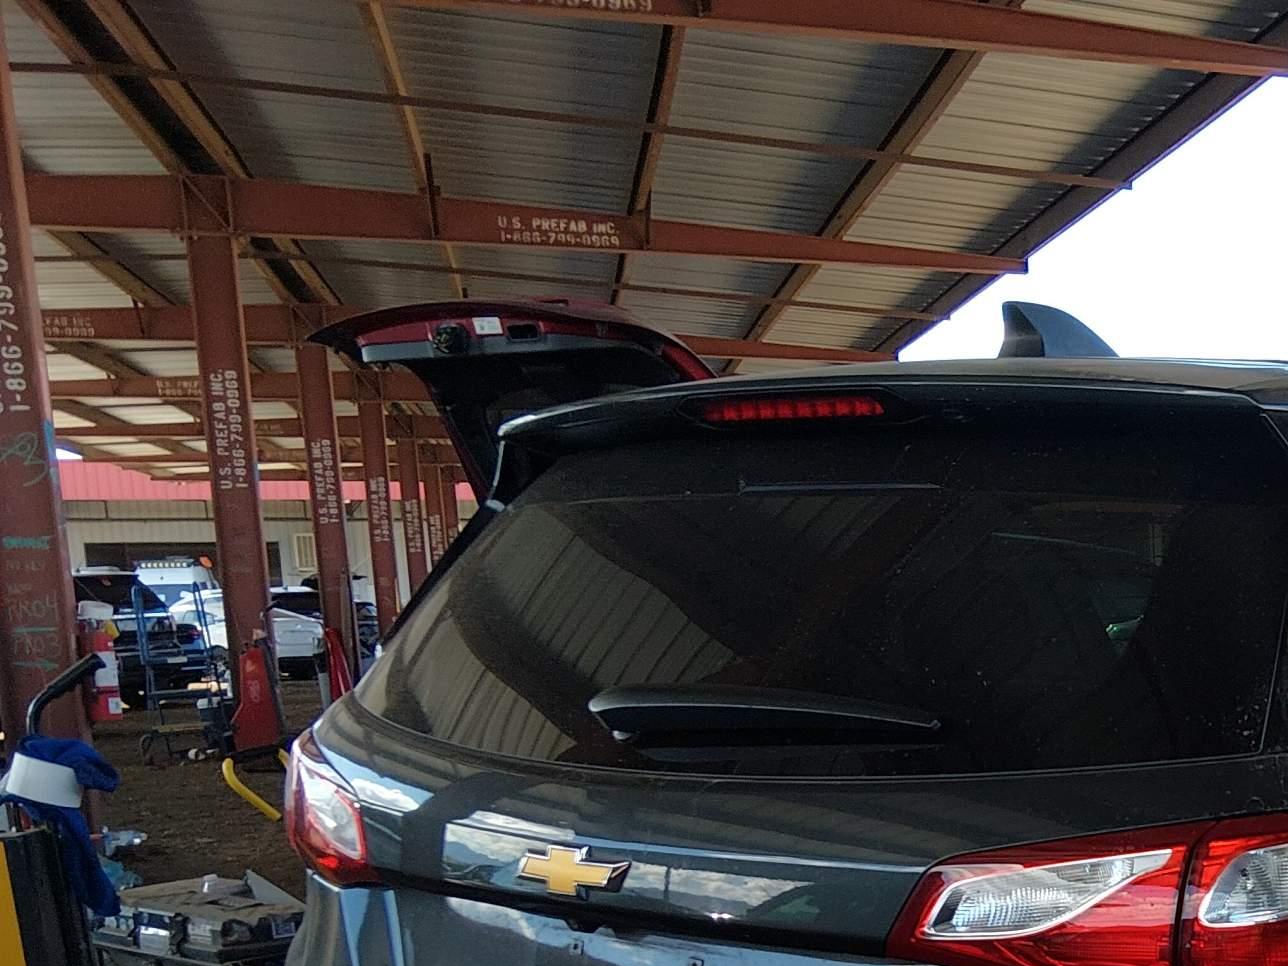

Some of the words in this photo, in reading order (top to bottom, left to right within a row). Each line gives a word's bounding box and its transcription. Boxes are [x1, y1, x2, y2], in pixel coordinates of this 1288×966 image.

[497, 215, 525, 230] U.S.
[531, 217, 587, 233] PREFAB
[592, 222, 620, 234] INC.
[209, 369, 225, 396] INC.
[211, 402, 230, 456] PREFAB
[219, 462, 233, 490] U.S.
